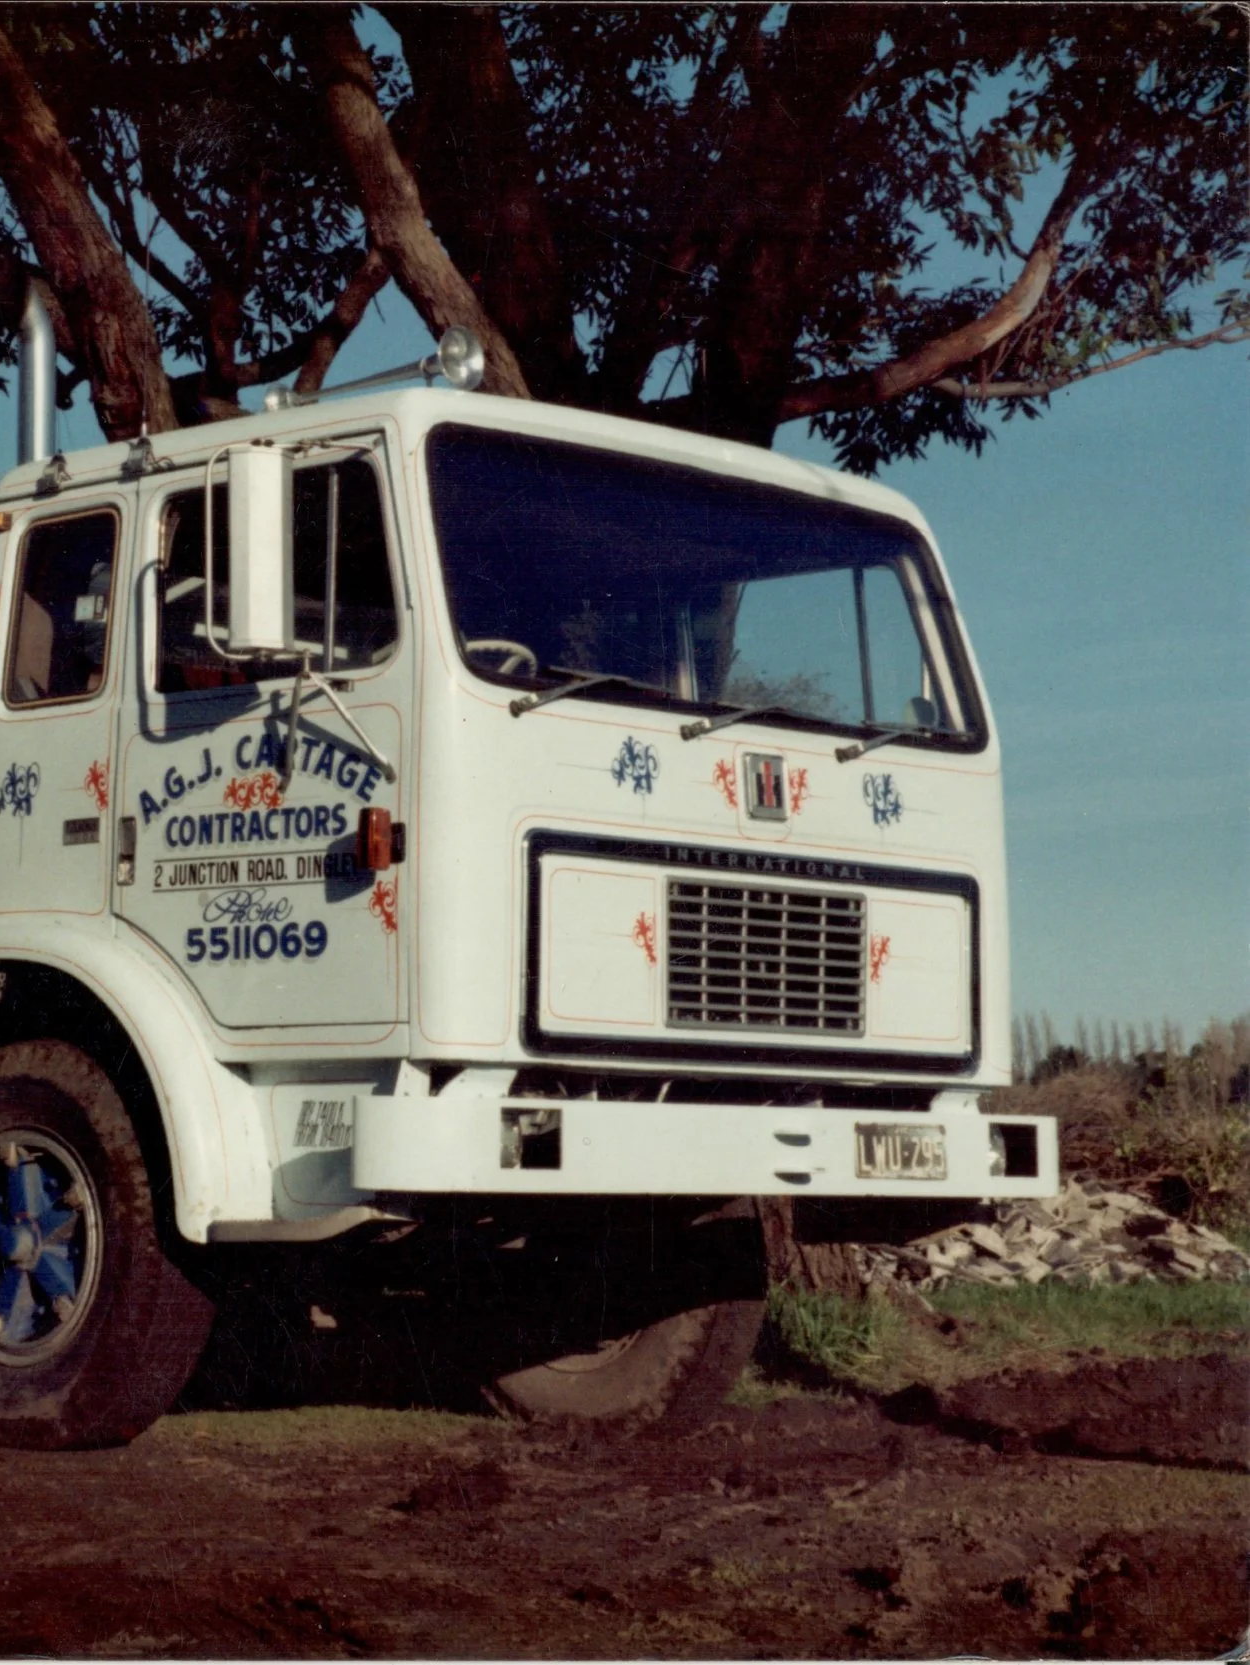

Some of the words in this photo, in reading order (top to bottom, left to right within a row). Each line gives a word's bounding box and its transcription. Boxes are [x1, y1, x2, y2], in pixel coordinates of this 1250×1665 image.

[138, 748, 222, 825] A.G.J.
[165, 803, 349, 848] CONTRACTORS
[153, 865, 164, 888] 2
[168, 861, 239, 887] JUNCTION
[664, 846, 866, 881] INTERNATIONAL
[202, 888, 293, 925] Phone
[186, 920, 329, 963] 5511069
